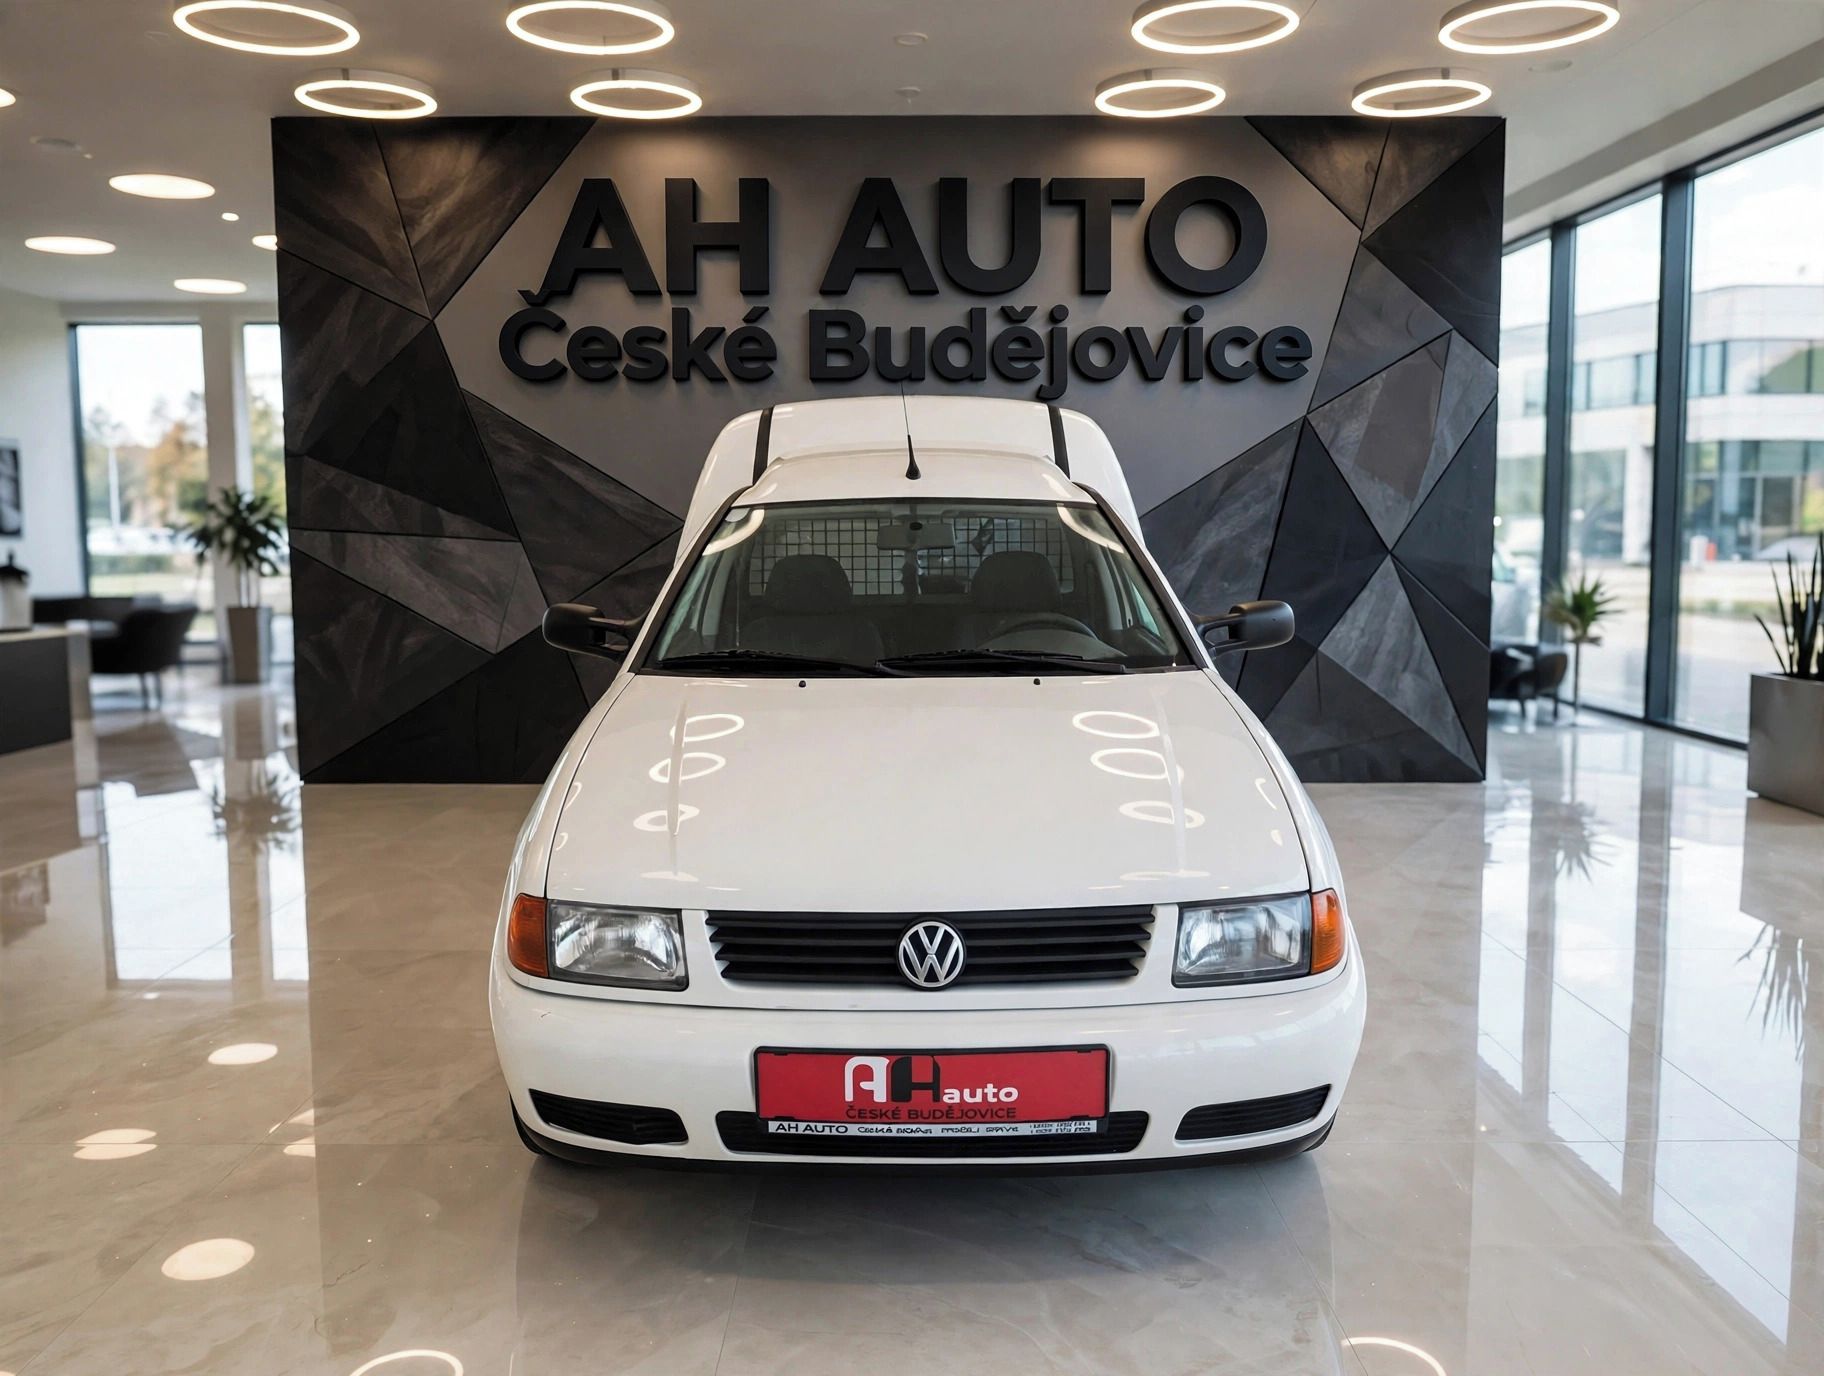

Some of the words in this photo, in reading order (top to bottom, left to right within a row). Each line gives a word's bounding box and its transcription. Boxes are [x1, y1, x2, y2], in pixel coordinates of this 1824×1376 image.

[538, 177, 770, 296] AH
[819, 175, 1268, 296] AUTO
[498, 289, 778, 383] České
[808, 304, 1313, 400] Budějovice
[775, 1122, 799, 1133] AH
[802, 1122, 849, 1135] AUTO
[845, 1105, 902, 1120] ČESKÉ
[907, 1105, 1017, 1120] BUDĚJOVICE
